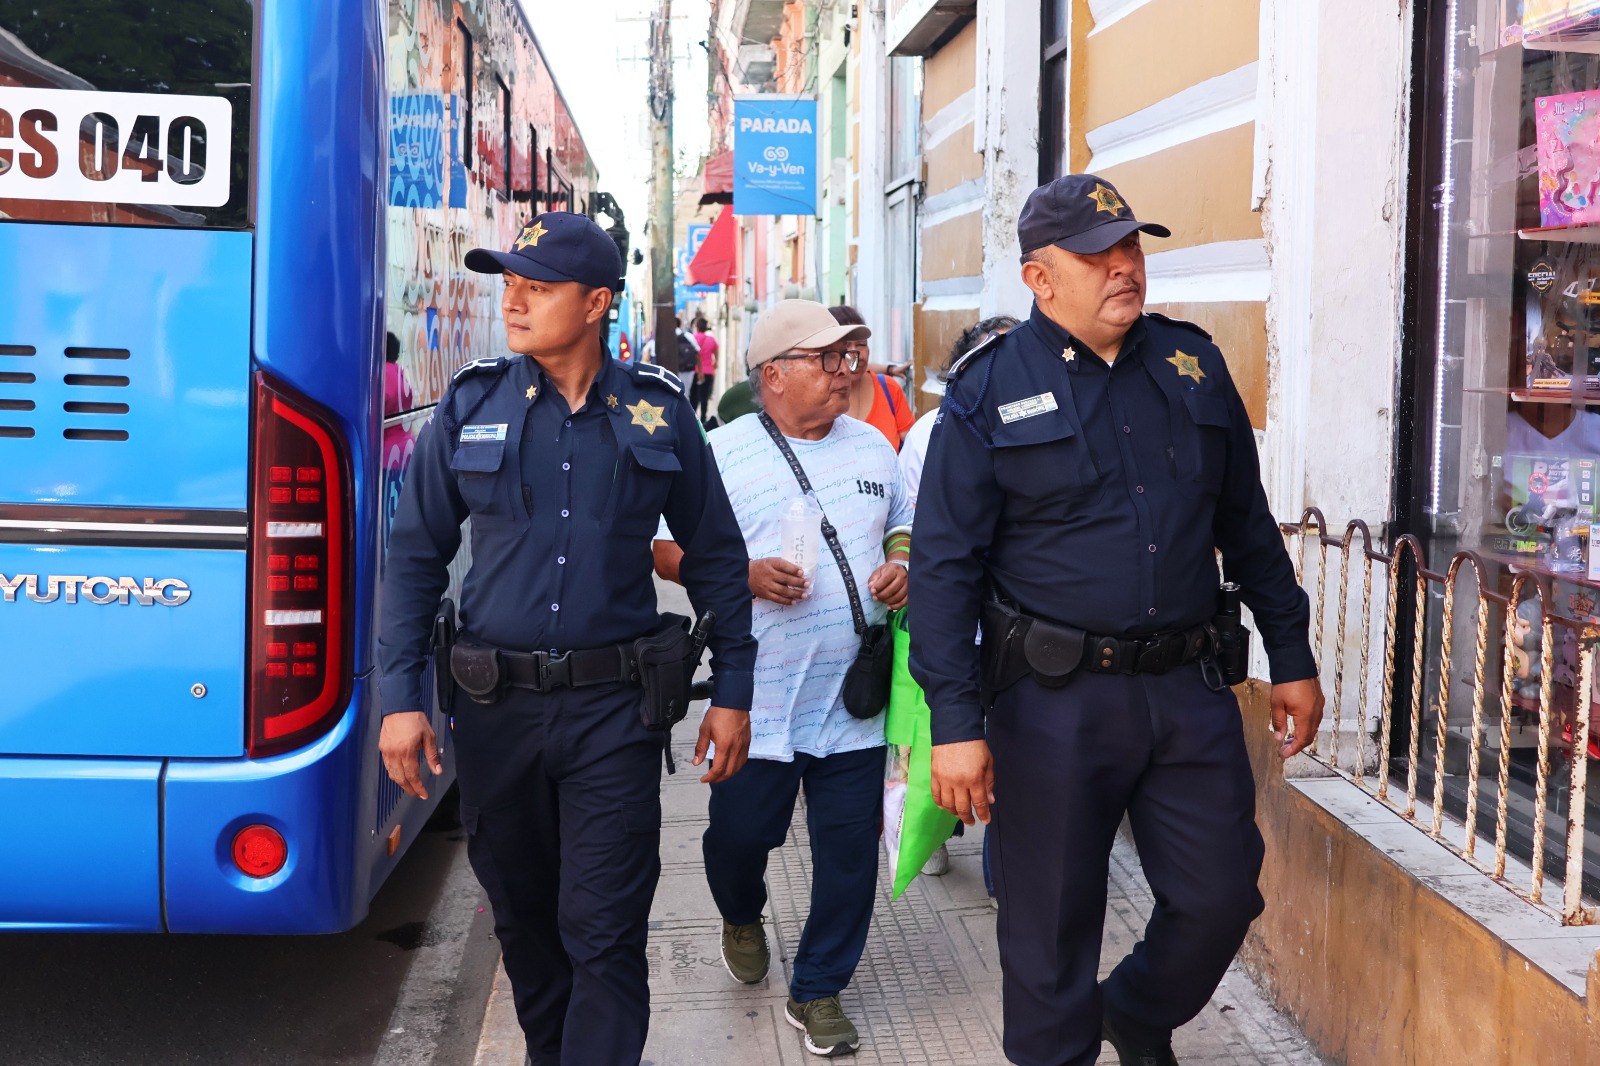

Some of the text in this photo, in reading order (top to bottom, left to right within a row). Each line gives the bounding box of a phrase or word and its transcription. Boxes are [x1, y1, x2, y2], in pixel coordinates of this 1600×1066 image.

[740, 118, 812, 135] PARADA
[78, 111, 207, 186] 040
[747, 161, 805, 177] Va-y-Ven
[856, 479, 885, 499] 1998
[0, 573, 192, 607] YUTONG
